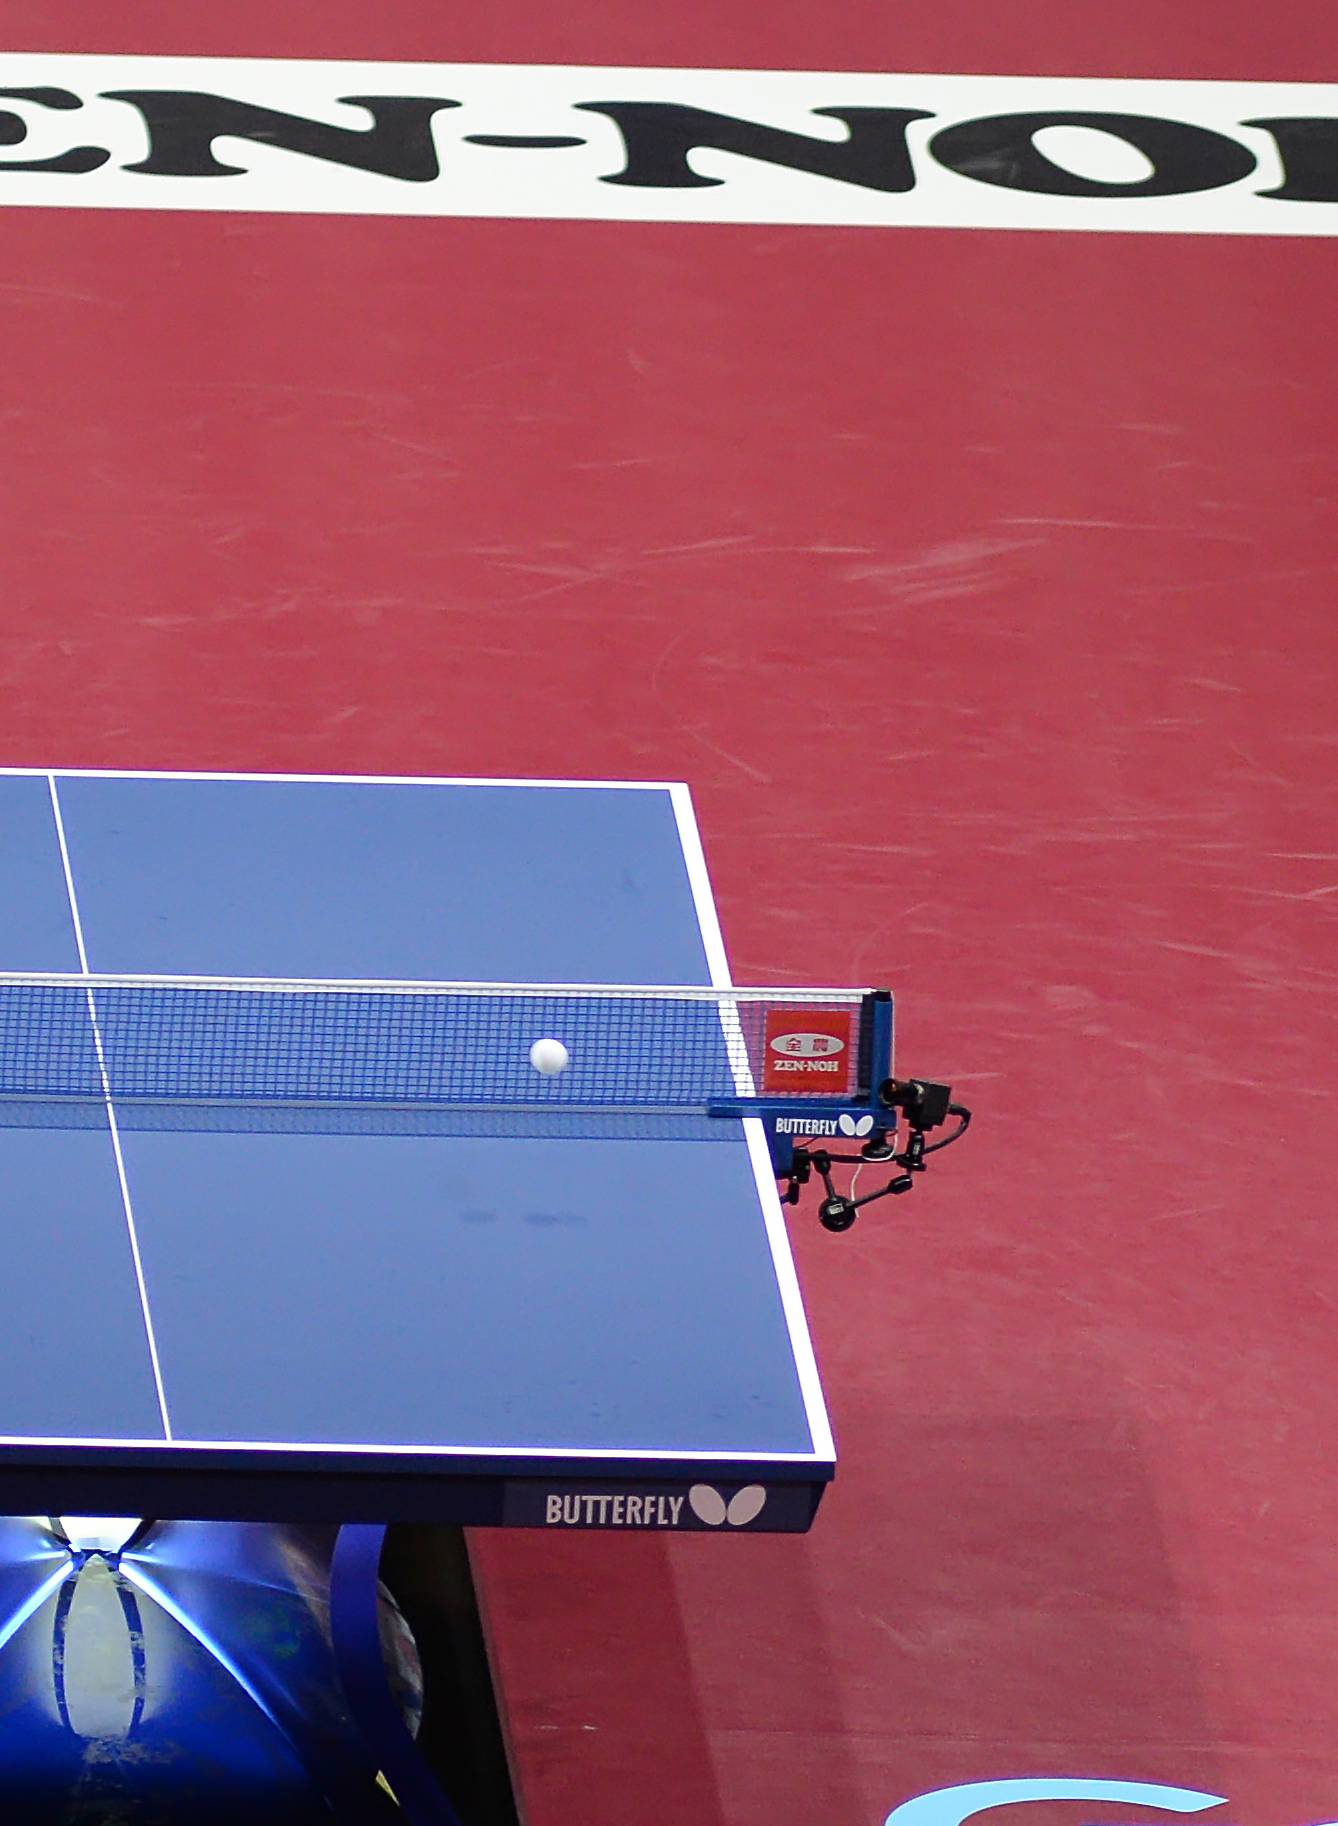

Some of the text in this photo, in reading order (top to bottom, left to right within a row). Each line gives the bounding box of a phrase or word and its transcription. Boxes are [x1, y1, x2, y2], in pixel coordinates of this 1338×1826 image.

[774, 1060, 839, 1072] ZEN-NOH
[775, 1117, 838, 1135] BUTTERFLY
[546, 1494, 685, 1525] BUTTERFLY
